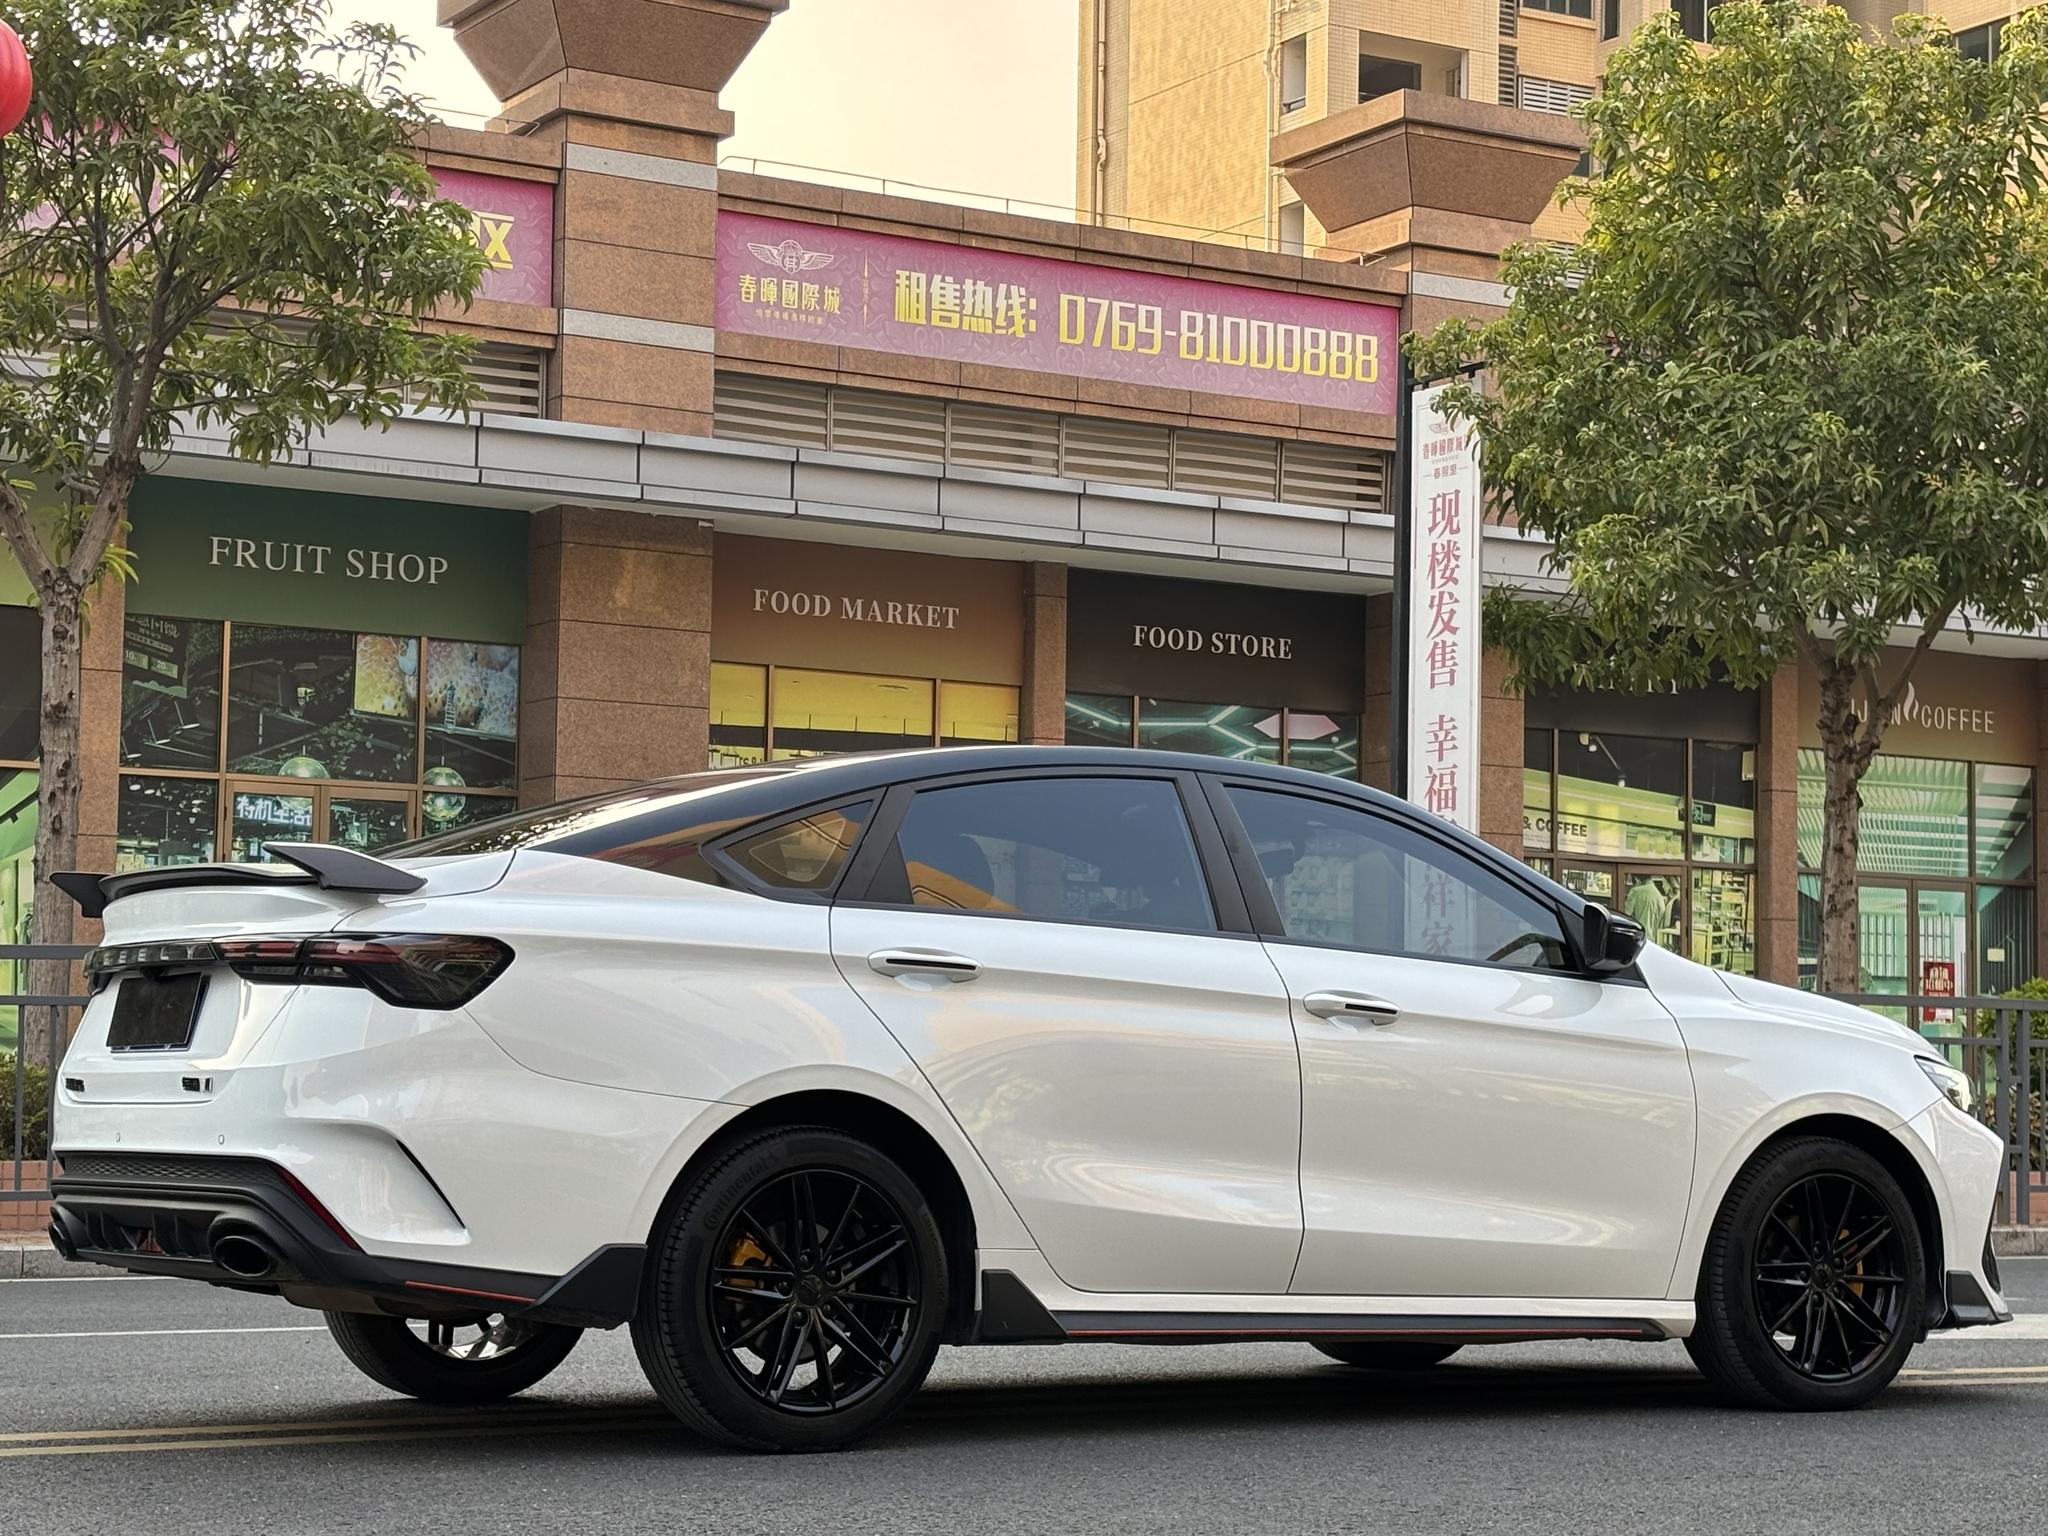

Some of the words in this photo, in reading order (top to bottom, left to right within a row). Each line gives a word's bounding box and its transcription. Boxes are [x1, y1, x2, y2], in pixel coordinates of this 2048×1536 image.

[738, 274, 841, 314] 春暉國際城
[894, 269, 1037, 338] 租售热线:
[1058, 293, 1379, 383] 0769-81000888
[209, 535, 331, 575] FRUIT
[346, 548, 449, 585] SHOP
[753, 588, 832, 617] FOOD
[840, 597, 960, 629] MARKET
[1426, 489, 1462, 690] 现楼发售
[1133, 624, 1203, 652] FOOD
[1211, 632, 1292, 660] STORE
[1921, 704, 1995, 734] COFFEE
